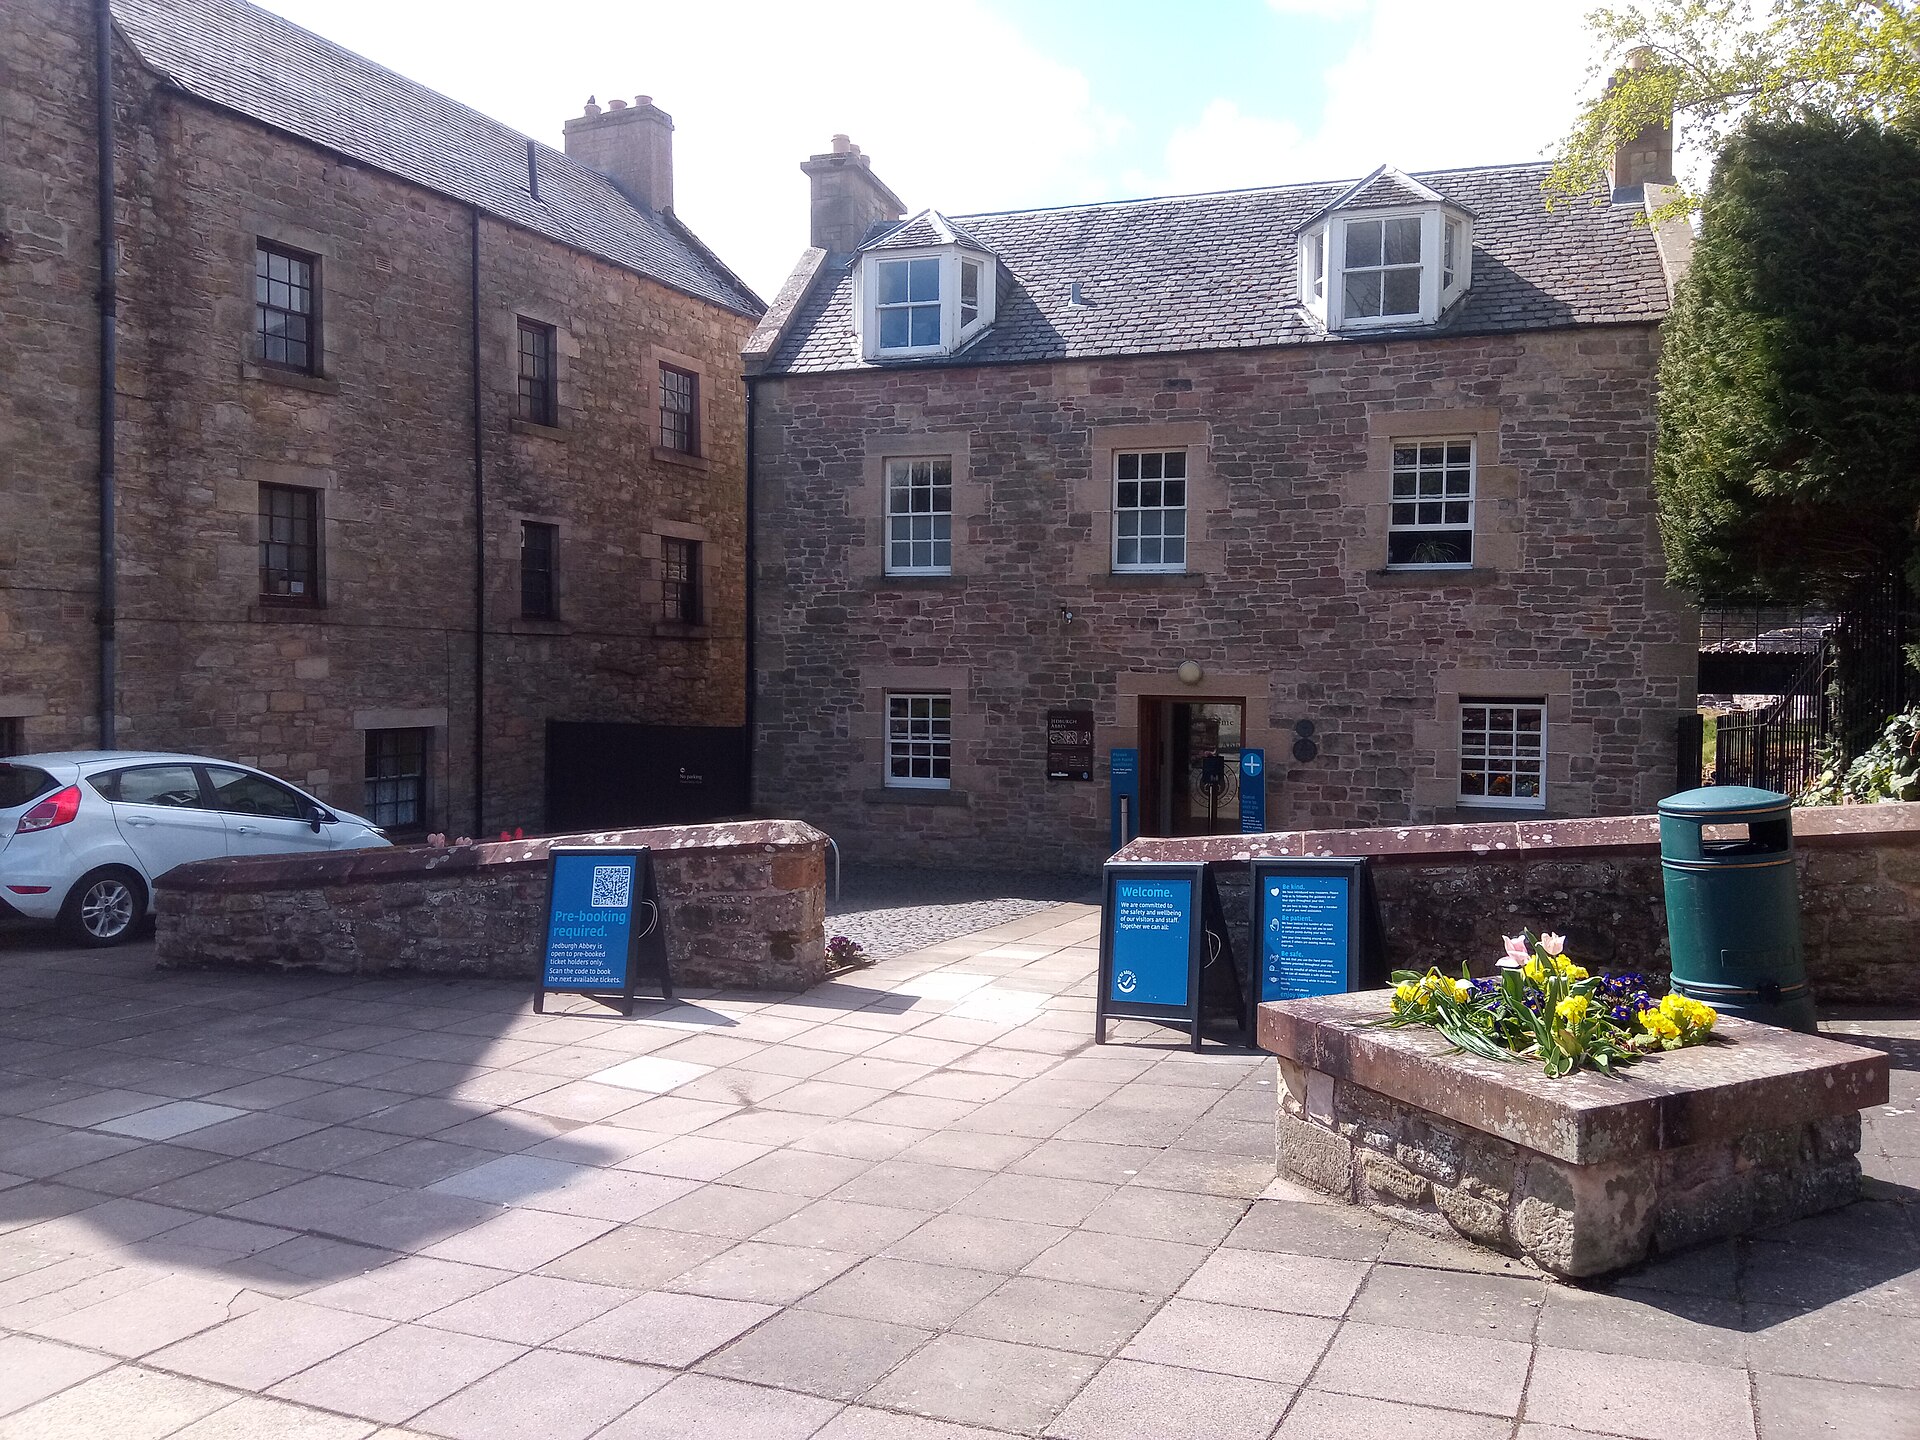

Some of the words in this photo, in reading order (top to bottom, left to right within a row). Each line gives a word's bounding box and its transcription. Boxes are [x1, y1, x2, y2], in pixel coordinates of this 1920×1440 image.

[1122, 887, 1173, 897] Welcome.
[555, 910, 626, 924] Pre-booking
[554, 925, 607, 939] required.
